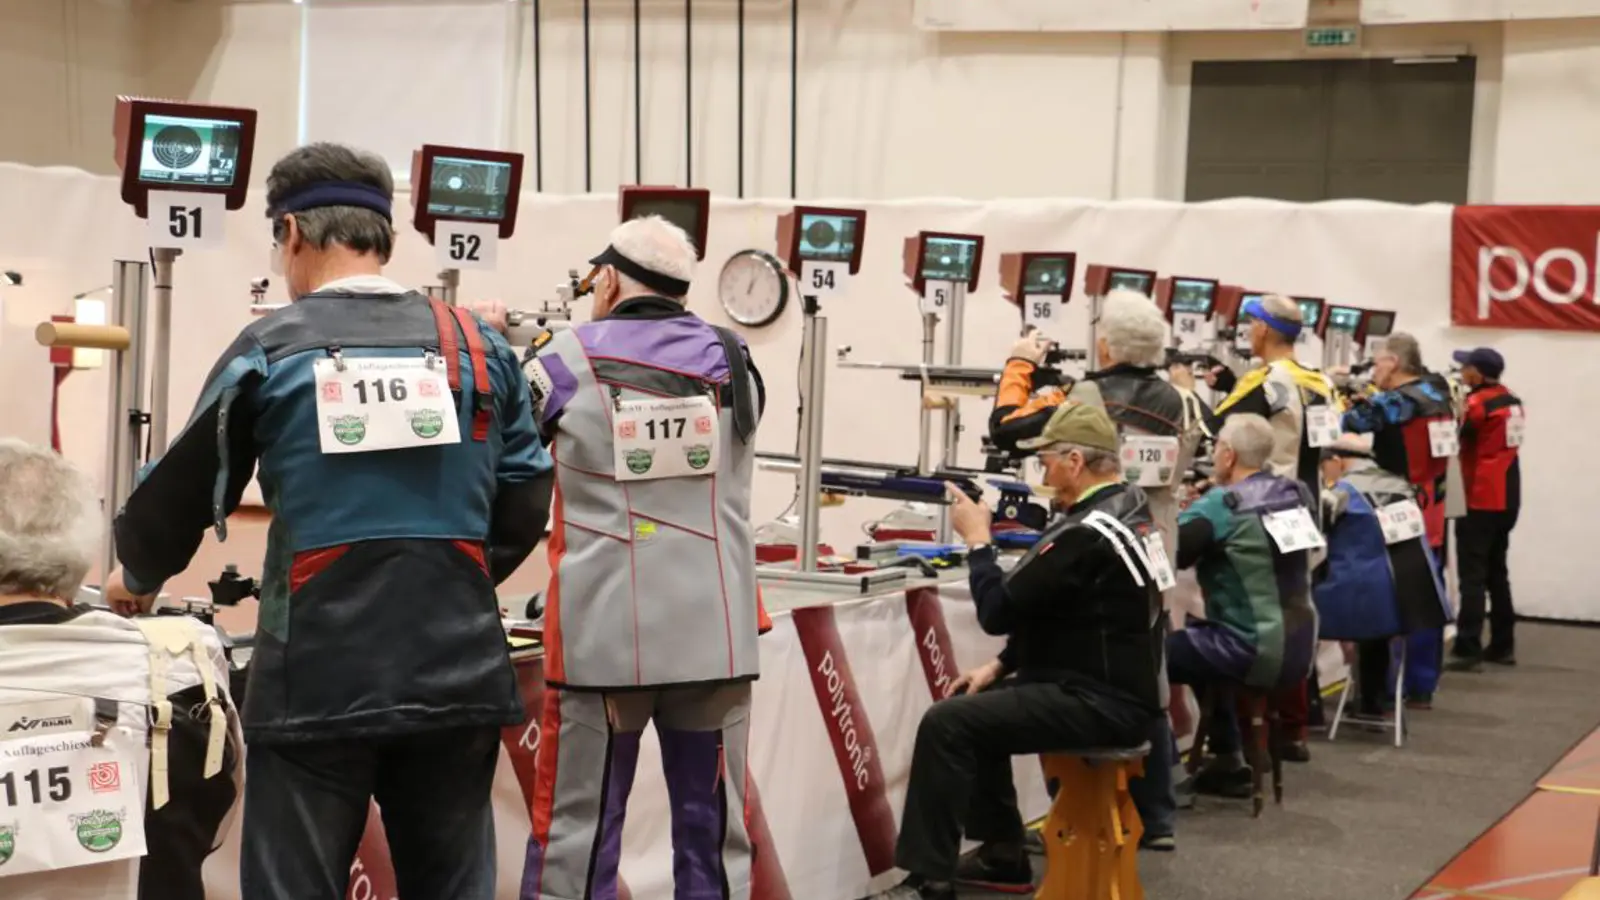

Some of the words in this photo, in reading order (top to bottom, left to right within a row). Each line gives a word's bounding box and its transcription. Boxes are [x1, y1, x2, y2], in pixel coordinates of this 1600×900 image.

[169, 205, 202, 239] 51
[449, 233, 481, 261] 52
[813, 269, 835, 290] 54
[935, 288, 949, 307] 5
[1033, 302, 1051, 318] 56
[353, 377, 408, 404] 116
[645, 417, 687, 440] 117
[1138, 448, 1162, 463] 120
[817, 649, 870, 791] polytronic
[0, 765, 72, 807] 115
